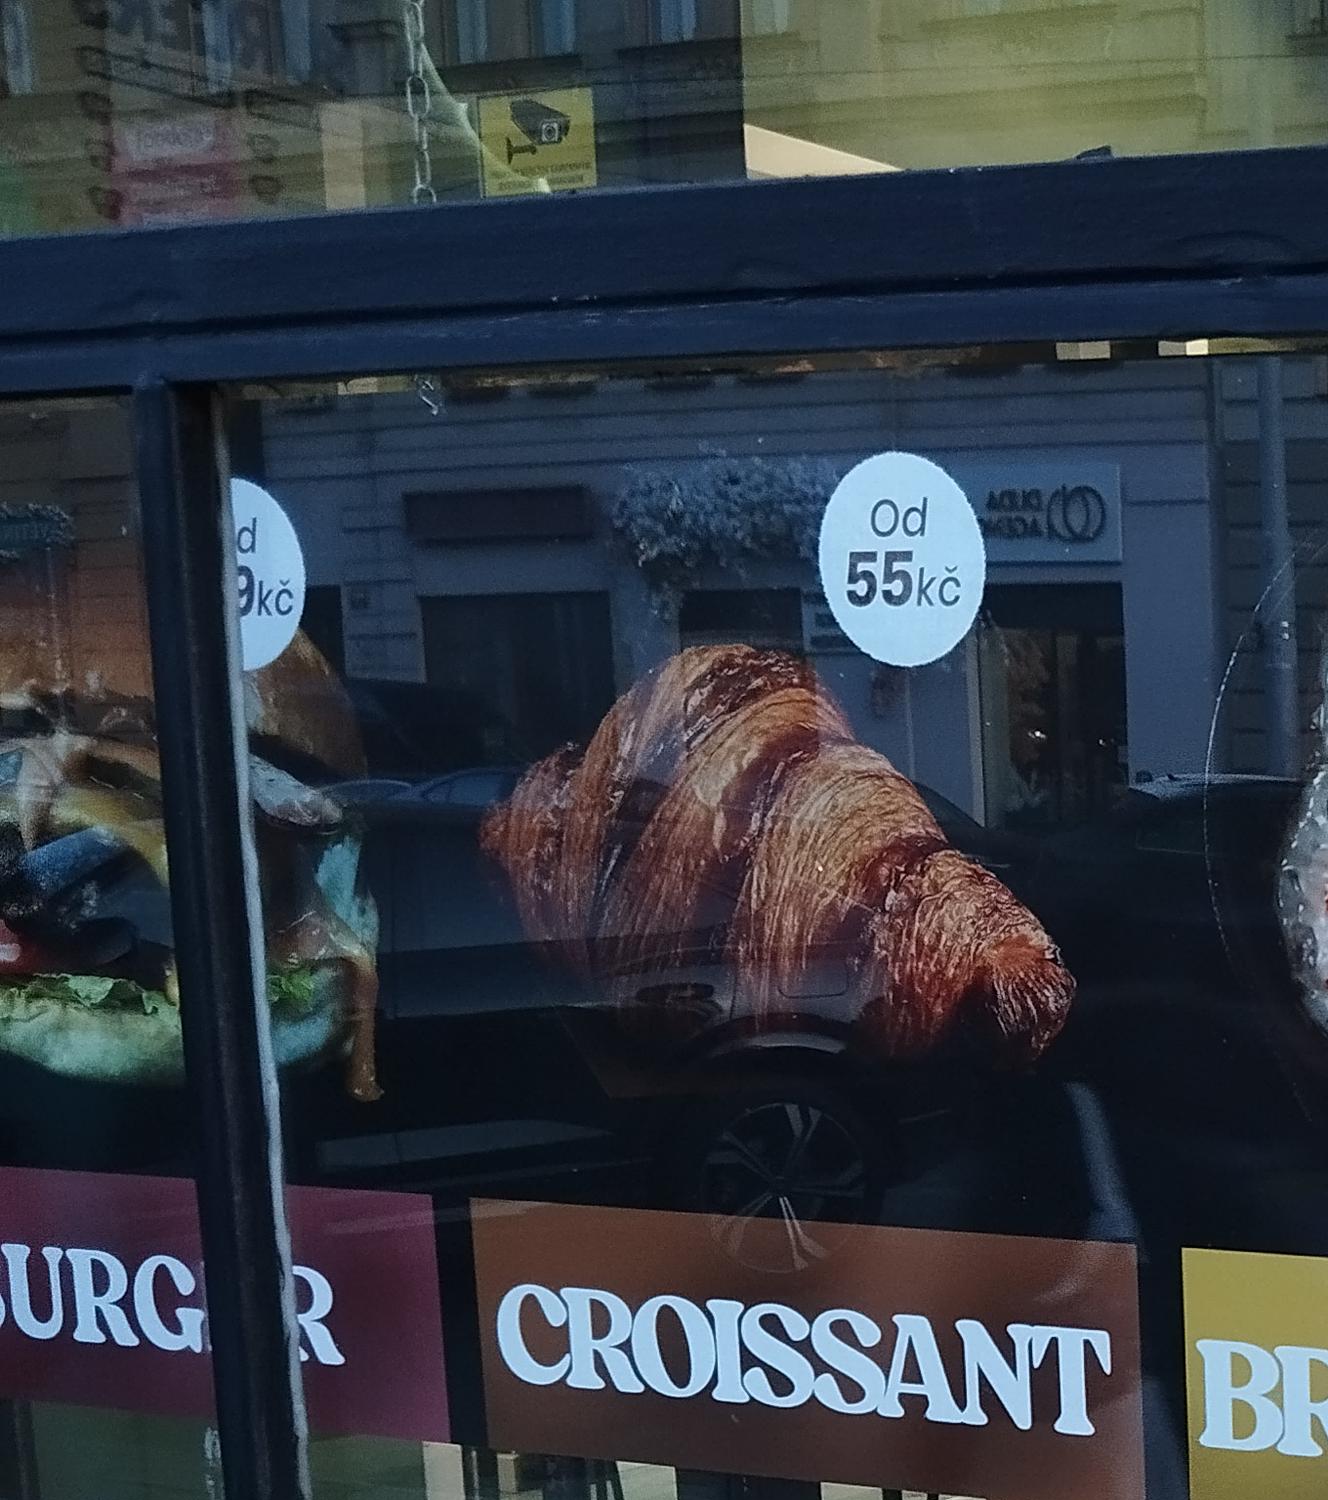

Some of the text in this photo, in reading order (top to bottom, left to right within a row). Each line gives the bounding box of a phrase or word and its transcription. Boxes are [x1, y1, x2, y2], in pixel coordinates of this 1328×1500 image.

[237, 517, 257, 554] d
[870, 497, 928, 537] Od
[238, 565, 294, 617] 9kč
[846, 550, 961, 607] 55kč
[0, 1243, 346, 1366] URGR
[496, 1283, 1112, 1436] CROISSANT
